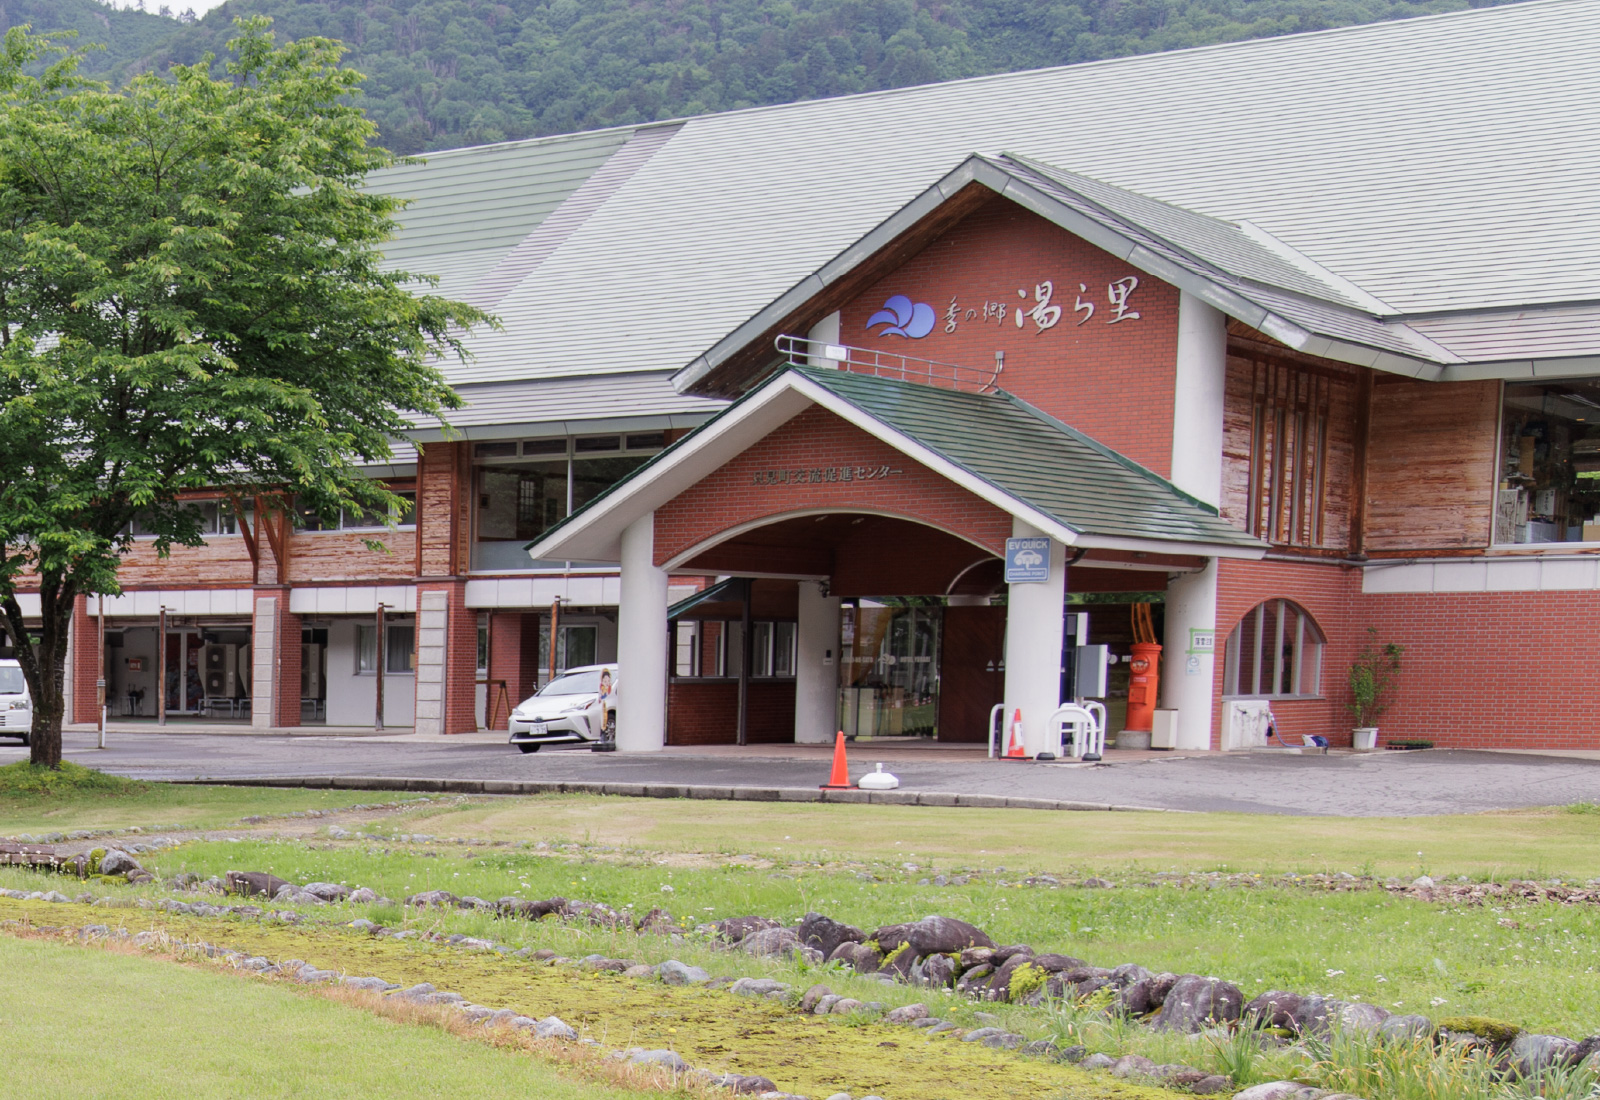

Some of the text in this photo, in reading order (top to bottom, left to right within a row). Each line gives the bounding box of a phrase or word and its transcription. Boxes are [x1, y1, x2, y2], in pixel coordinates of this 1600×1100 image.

[941, 276, 1141, 334] 季の郷 湯ら里
[752, 465, 904, 486] 只見町交流促進センター
[1008, 540, 1048, 550] EV QUICK
